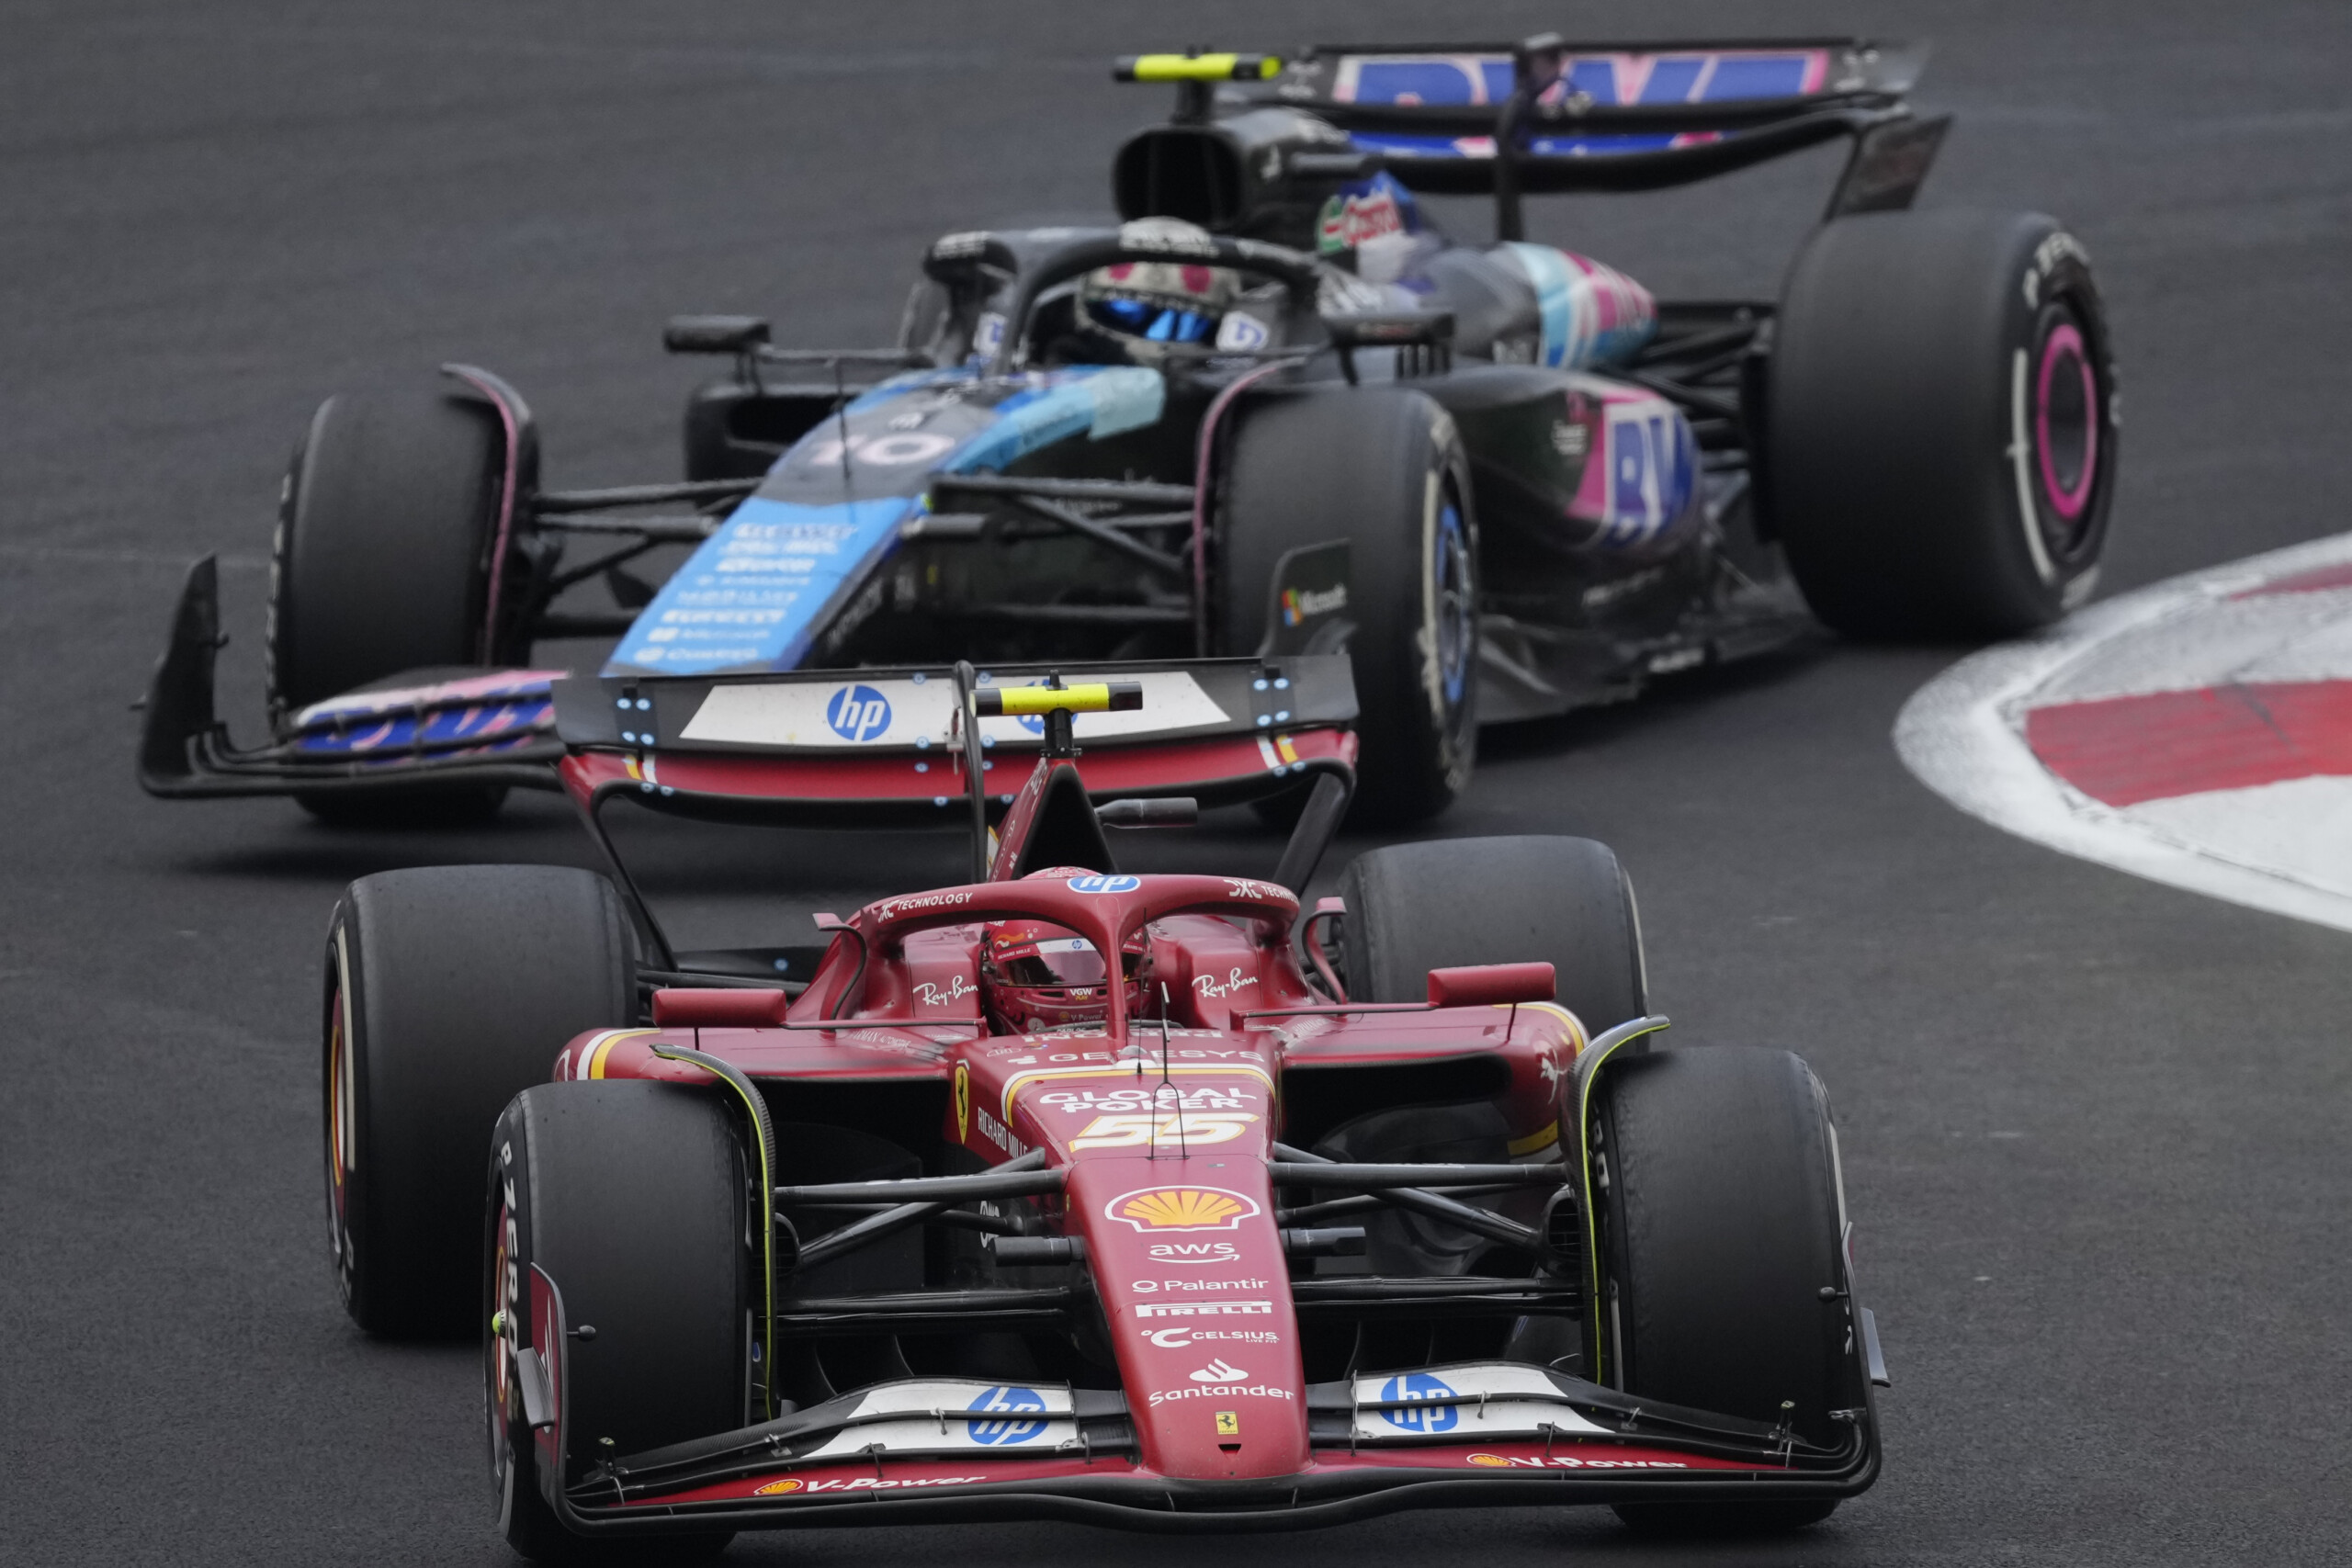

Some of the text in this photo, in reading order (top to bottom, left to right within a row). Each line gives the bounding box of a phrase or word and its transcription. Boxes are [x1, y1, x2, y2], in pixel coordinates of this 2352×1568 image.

[834, 685, 887, 741] hp
[897, 892, 973, 911] TECHNOLOGY
[1048, 1049, 1265, 1063] GEESYS
[1039, 1088, 1258, 1104] GLOBAL
[1061, 1098, 1243, 1113] POKER
[978, 1106, 1007, 1152] RICHARD
[1069, 1112, 1261, 1154] 55
[1149, 1242, 1236, 1256] aws
[1165, 1278, 1269, 1292] Palantir
[1136, 1301, 1272, 1318] PIRELLI
[1148, 1385, 1295, 1408] Santander
[1510, 1456, 1689, 1469] V-Power
[807, 1475, 989, 1493] V-Power
